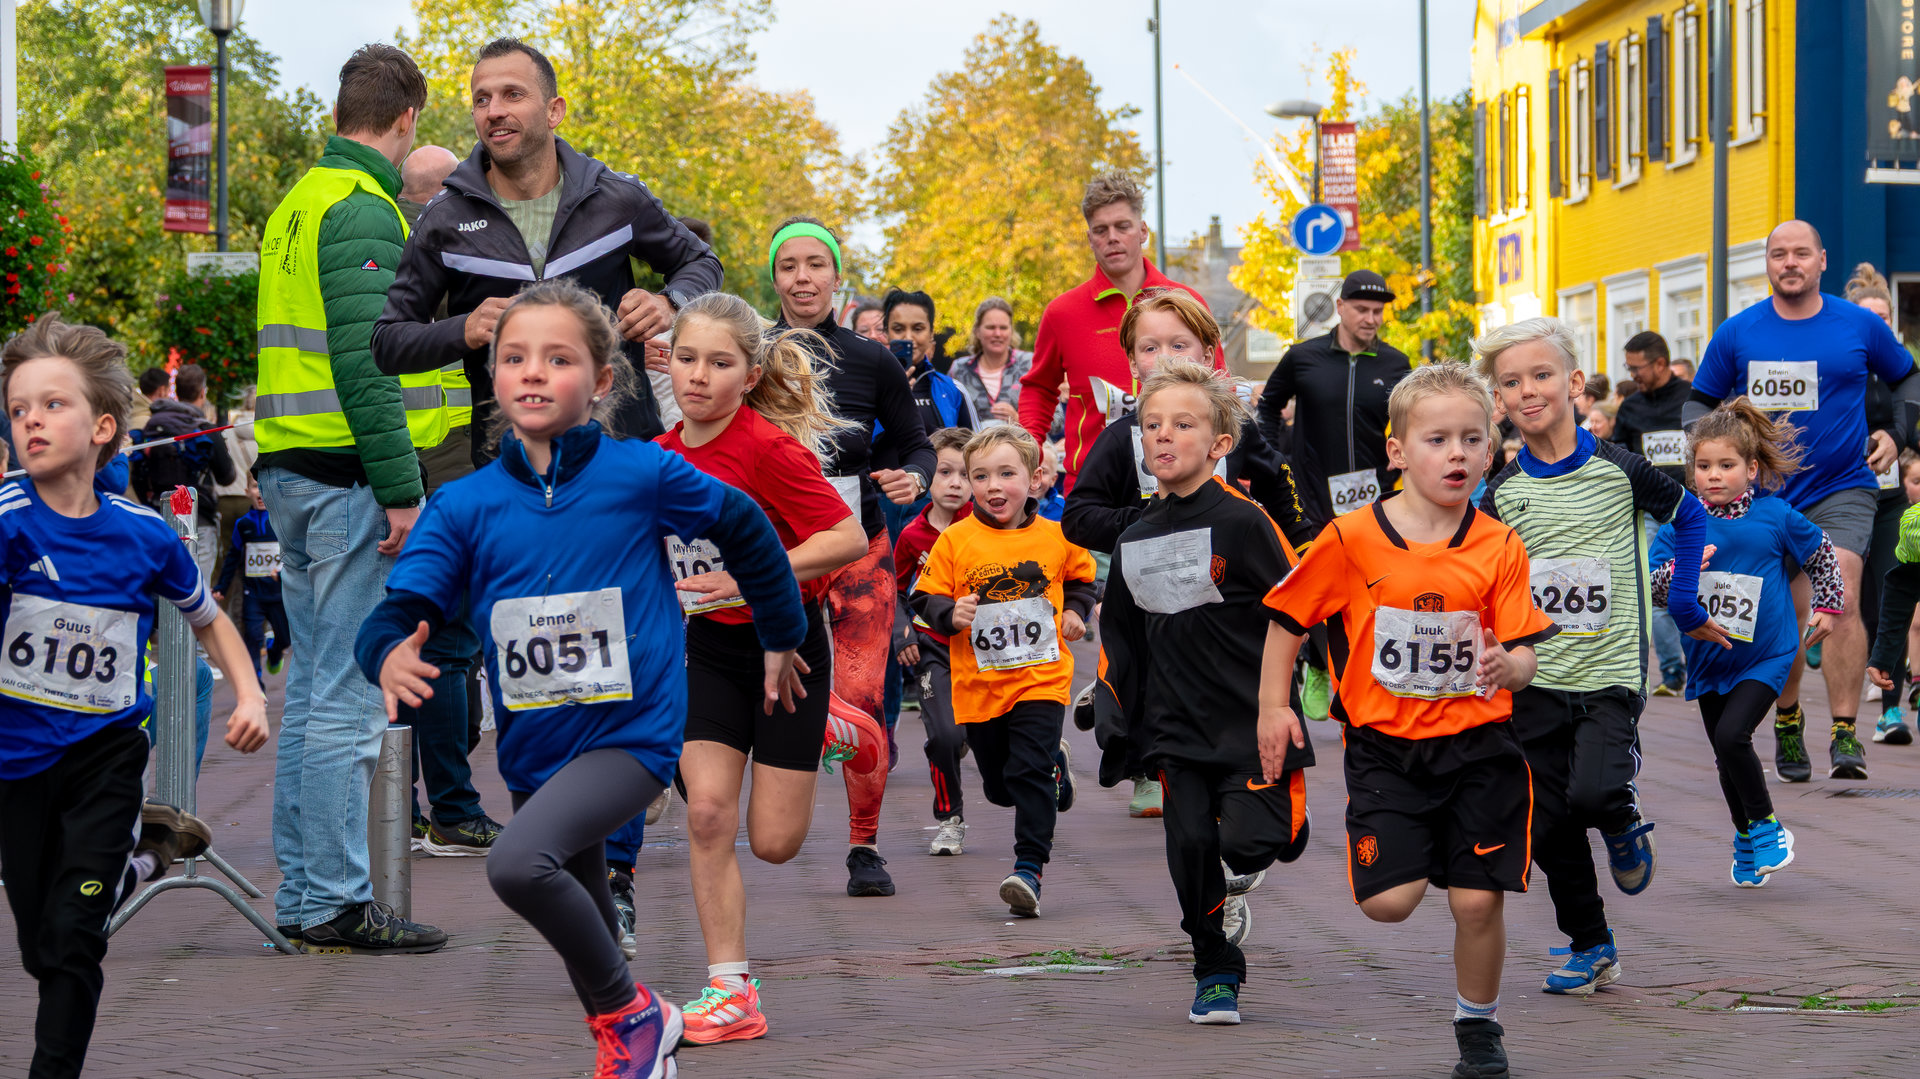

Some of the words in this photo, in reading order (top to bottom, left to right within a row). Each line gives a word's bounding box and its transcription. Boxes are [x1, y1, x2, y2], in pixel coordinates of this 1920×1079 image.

[458, 219, 488, 232] JAKO
[1752, 379, 1806, 396] 6050
[1647, 443, 1681, 458] 6065
[1335, 483, 1377, 505] 6269
[248, 554, 281, 567] 6099
[978, 566, 1001, 577] editie
[1714, 582, 1731, 590] Jule
[54, 618, 91, 634] Guus
[529, 613, 576, 627] Lenne
[975, 622, 1042, 651] 6319
[1414, 625, 1444, 635] Luuk
[8, 631, 117, 684] 6103
[505, 629, 613, 679] 6051
[1379, 639, 1474, 675] 6155
[1, 678, 15, 687] VAN
[17, 680, 36, 692] OERS
[43, 688, 79, 700] THETFORD
[1389, 681, 1406, 690] OERS
